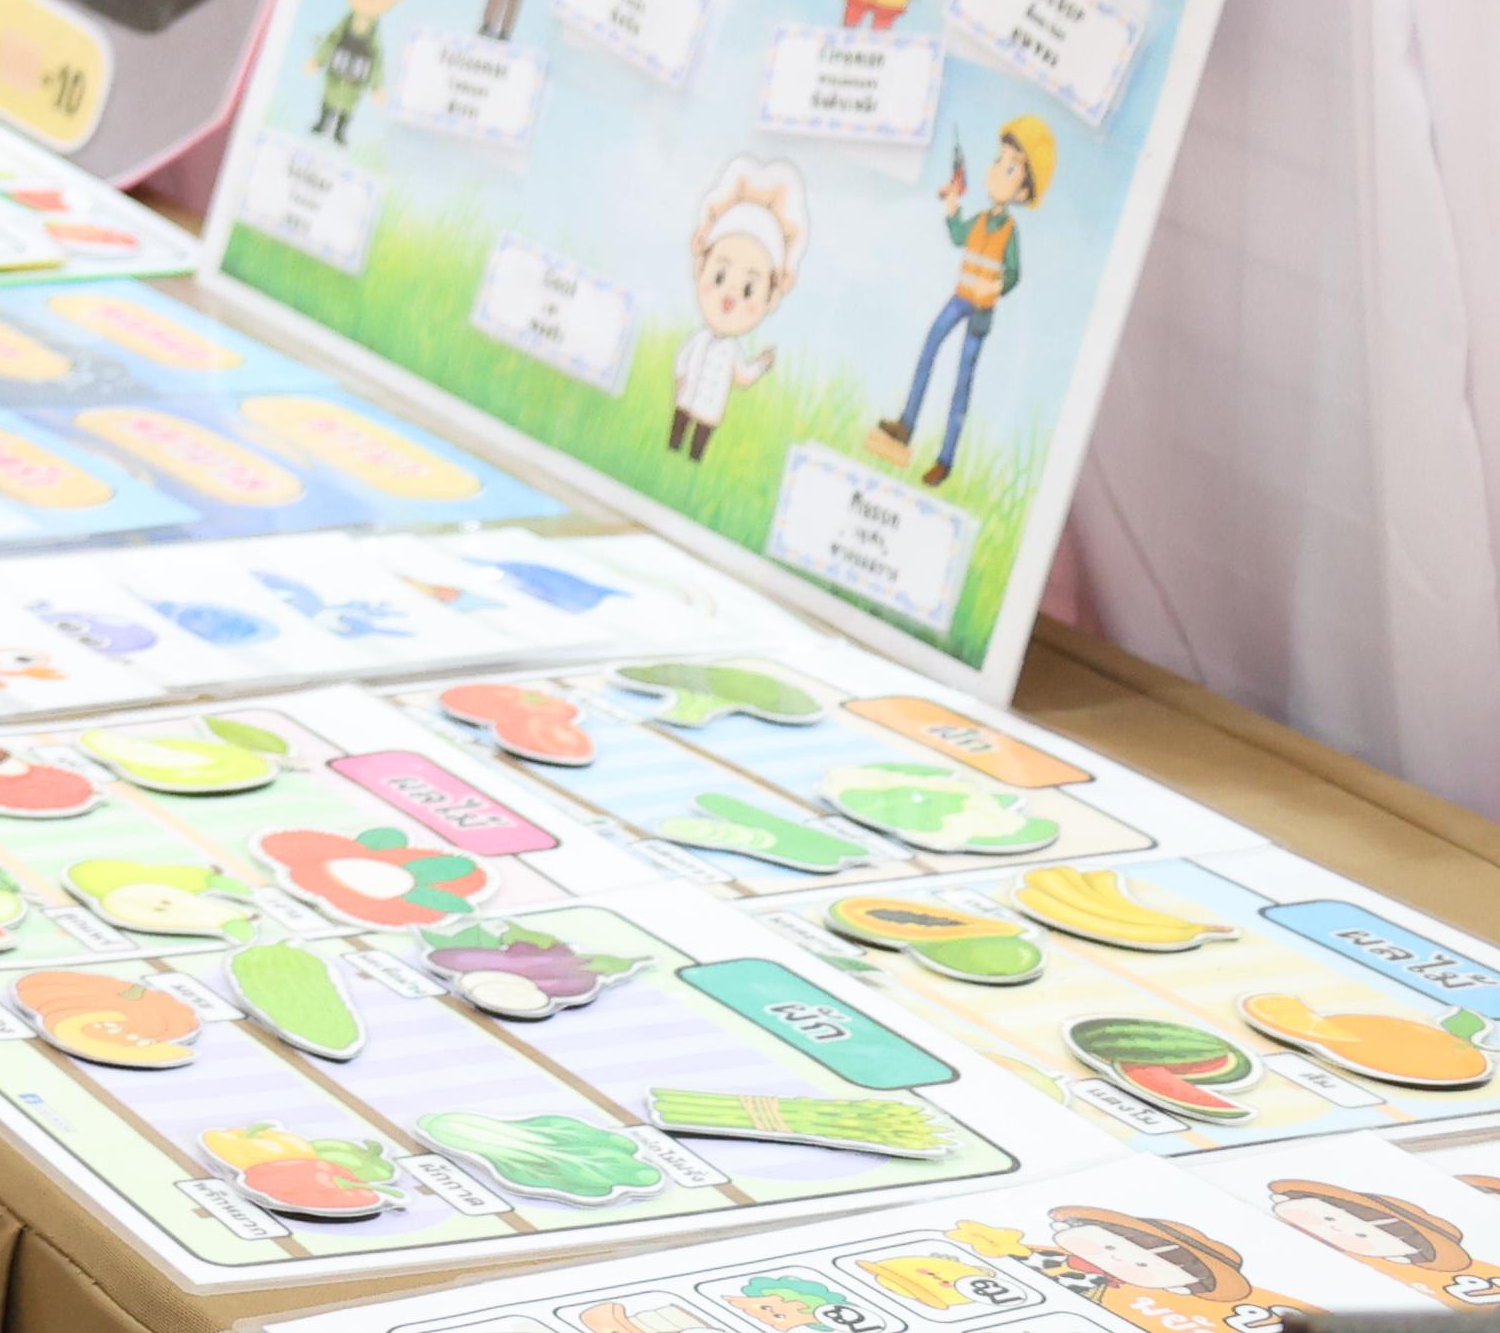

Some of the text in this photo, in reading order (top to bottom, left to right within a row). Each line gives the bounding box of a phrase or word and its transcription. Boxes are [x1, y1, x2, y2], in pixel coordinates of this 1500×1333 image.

[849, 489, 902, 533] Mason
[924, 724, 994, 754] ผัก
[385, 775, 512, 829] ผลไม้
[1334, 929, 1500, 991] ผลไม้
[767, 1001, 851, 1042] ผัก
[1085, 1086, 1162, 1128] แตงโม
[416, 1160, 488, 1209] ผักกาด
[191, 1180, 270, 1238] พริกหยวก
